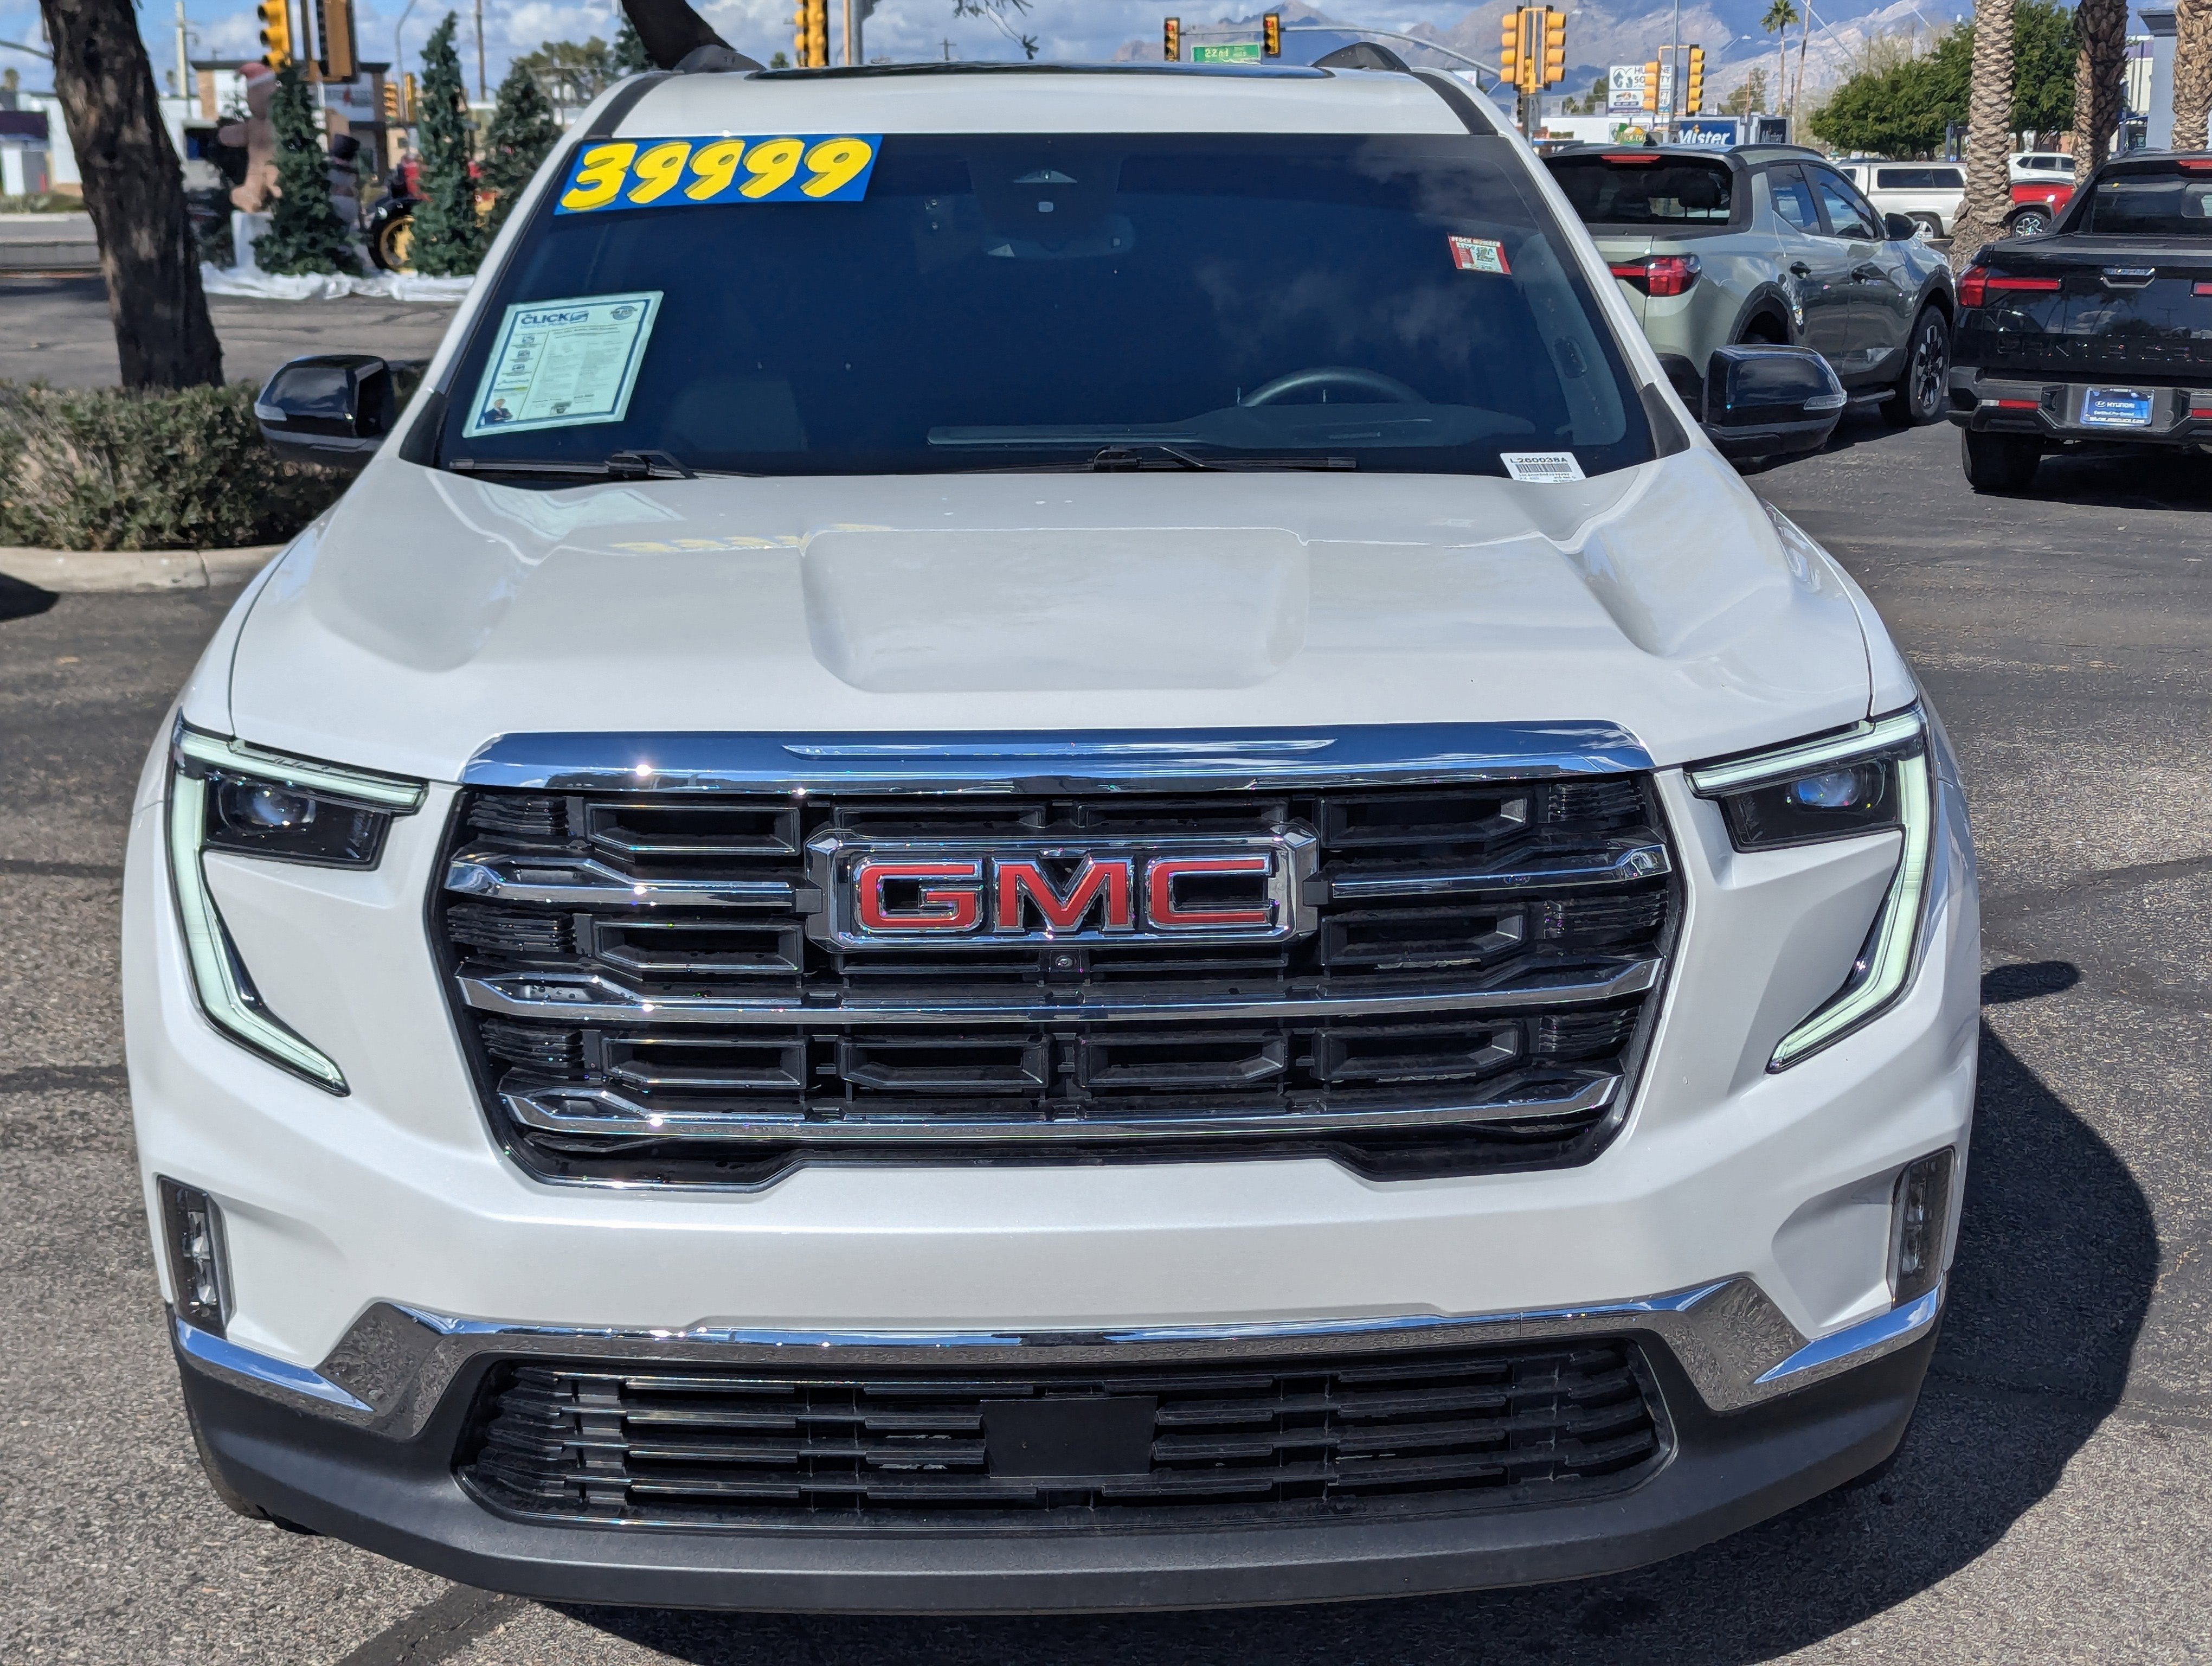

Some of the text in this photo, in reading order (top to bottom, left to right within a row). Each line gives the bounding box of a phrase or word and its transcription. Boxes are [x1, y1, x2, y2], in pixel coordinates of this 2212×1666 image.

[1205, 48, 1229, 58] 22nd
[1635, 75, 1670, 84] SOTY
[1678, 129, 1731, 145] Mister
[560, 137, 873, 211] 39999
[521, 312, 569, 325] CLICK
[856, 857, 1271, 932] GMC
